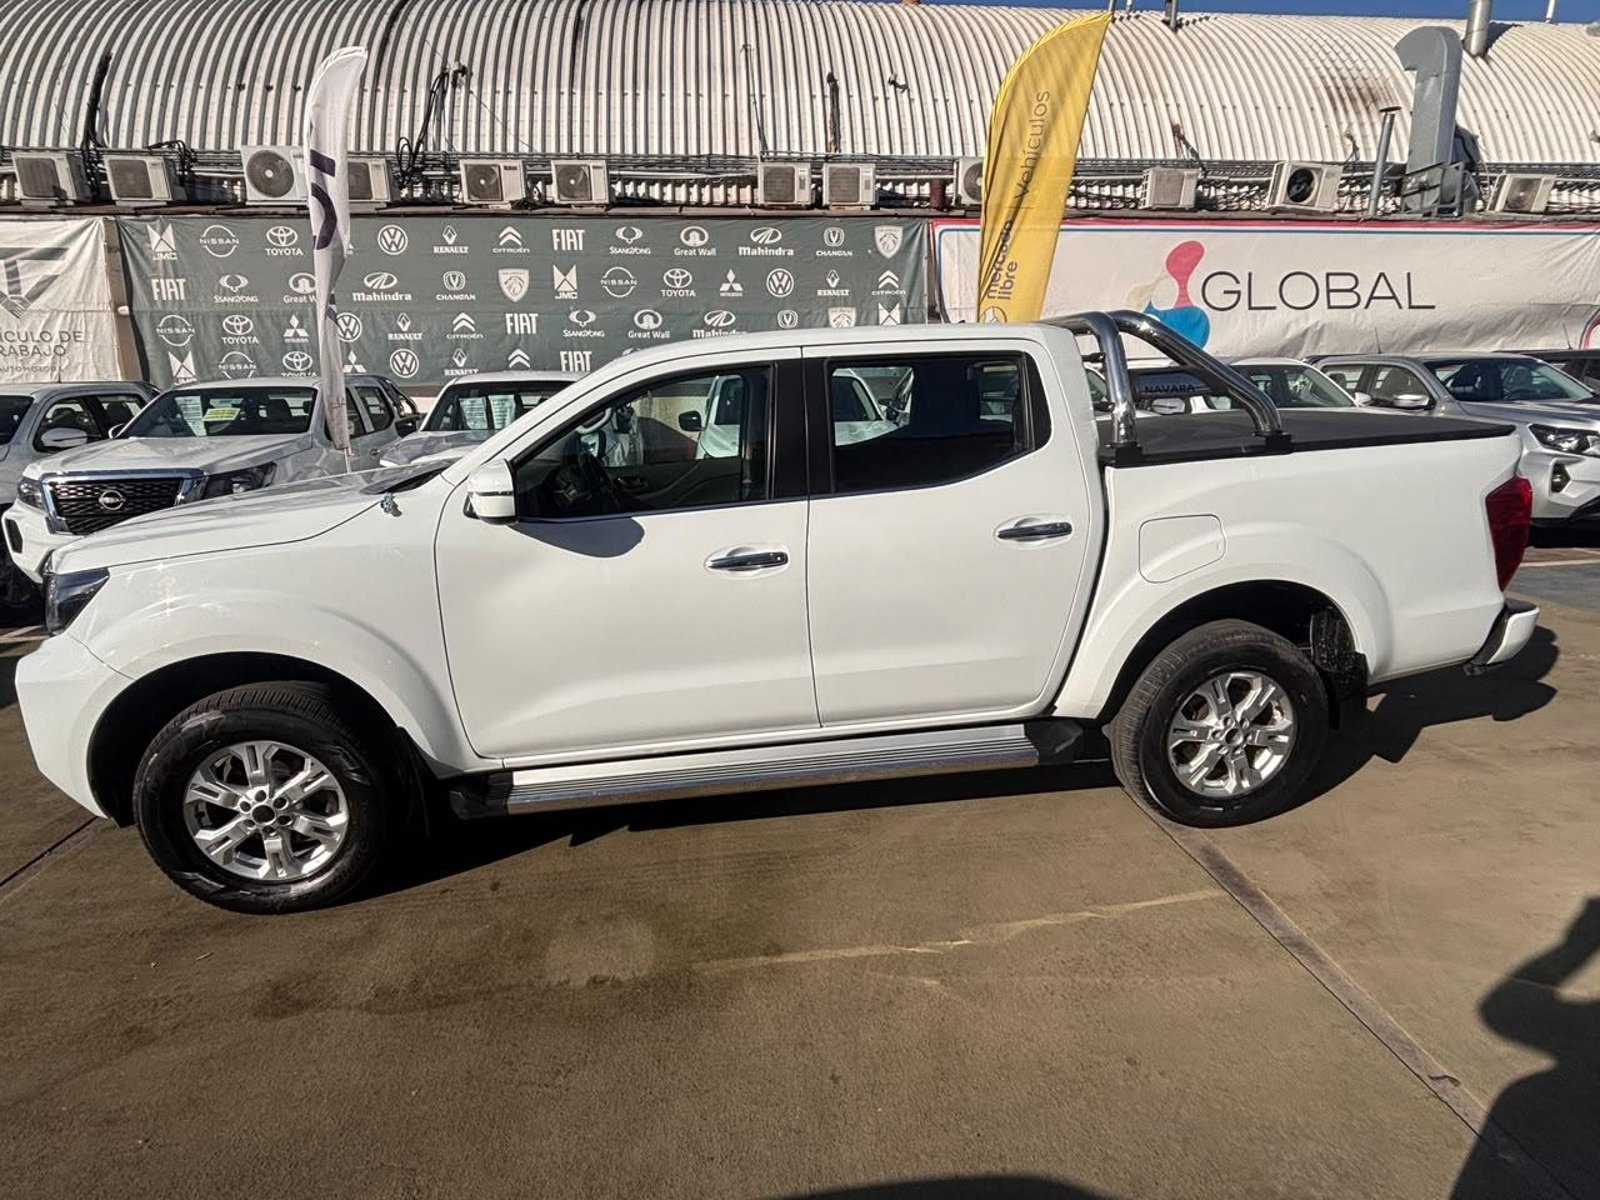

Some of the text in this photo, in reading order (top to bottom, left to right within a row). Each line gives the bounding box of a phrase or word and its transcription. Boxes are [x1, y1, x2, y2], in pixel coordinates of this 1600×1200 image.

[552, 229, 585, 250] FIAT
[265, 248, 303, 256] TOYOTA
[674, 248, 716, 256] Great Wall
[739, 247, 794, 256] Mahindra
[998, 261, 1018, 299] libre
[152, 279, 186, 300] FIAT
[661, 289, 696, 297] TOYOTA
[1201, 271, 1436, 312] GLOBAL
[284, 295, 308, 303] Great
[352, 292, 412, 301] Mahindra
[505, 313, 538, 334] FIAT
[58, 331, 85, 343] DE
[628, 330, 670, 338] Great Wall
[221, 336, 259, 345] TOYOTA
[560, 351, 592, 372] FIAT
[1144, 385, 1197, 393] NAVARA
